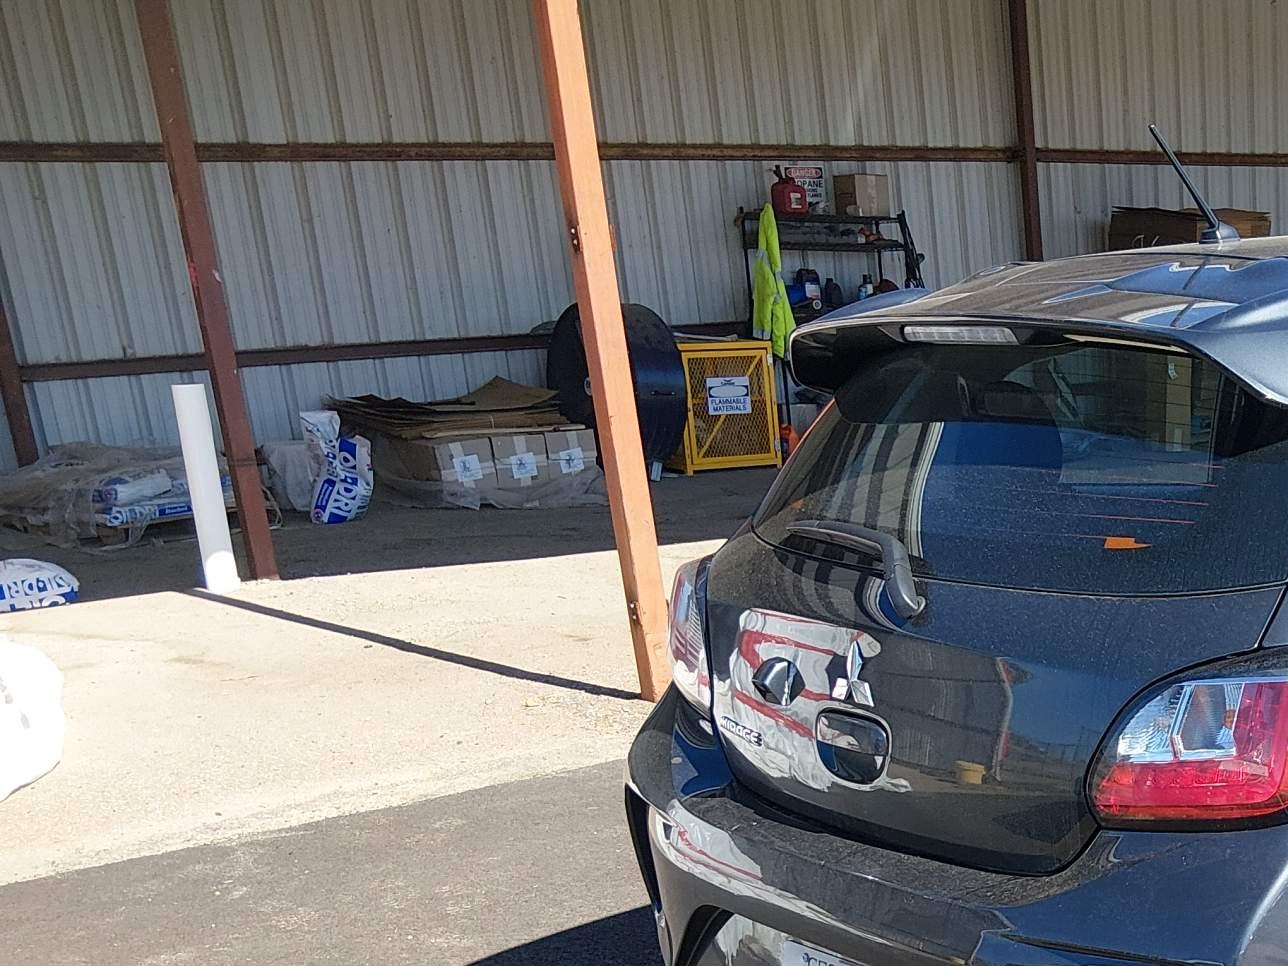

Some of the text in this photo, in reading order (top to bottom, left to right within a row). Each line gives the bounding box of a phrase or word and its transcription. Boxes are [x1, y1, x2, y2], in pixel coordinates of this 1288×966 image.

[711, 397, 748, 406] FLAMMABLE
[712, 404, 748, 413] MATERIALS
[720, 715, 763, 747] MIRAGE
